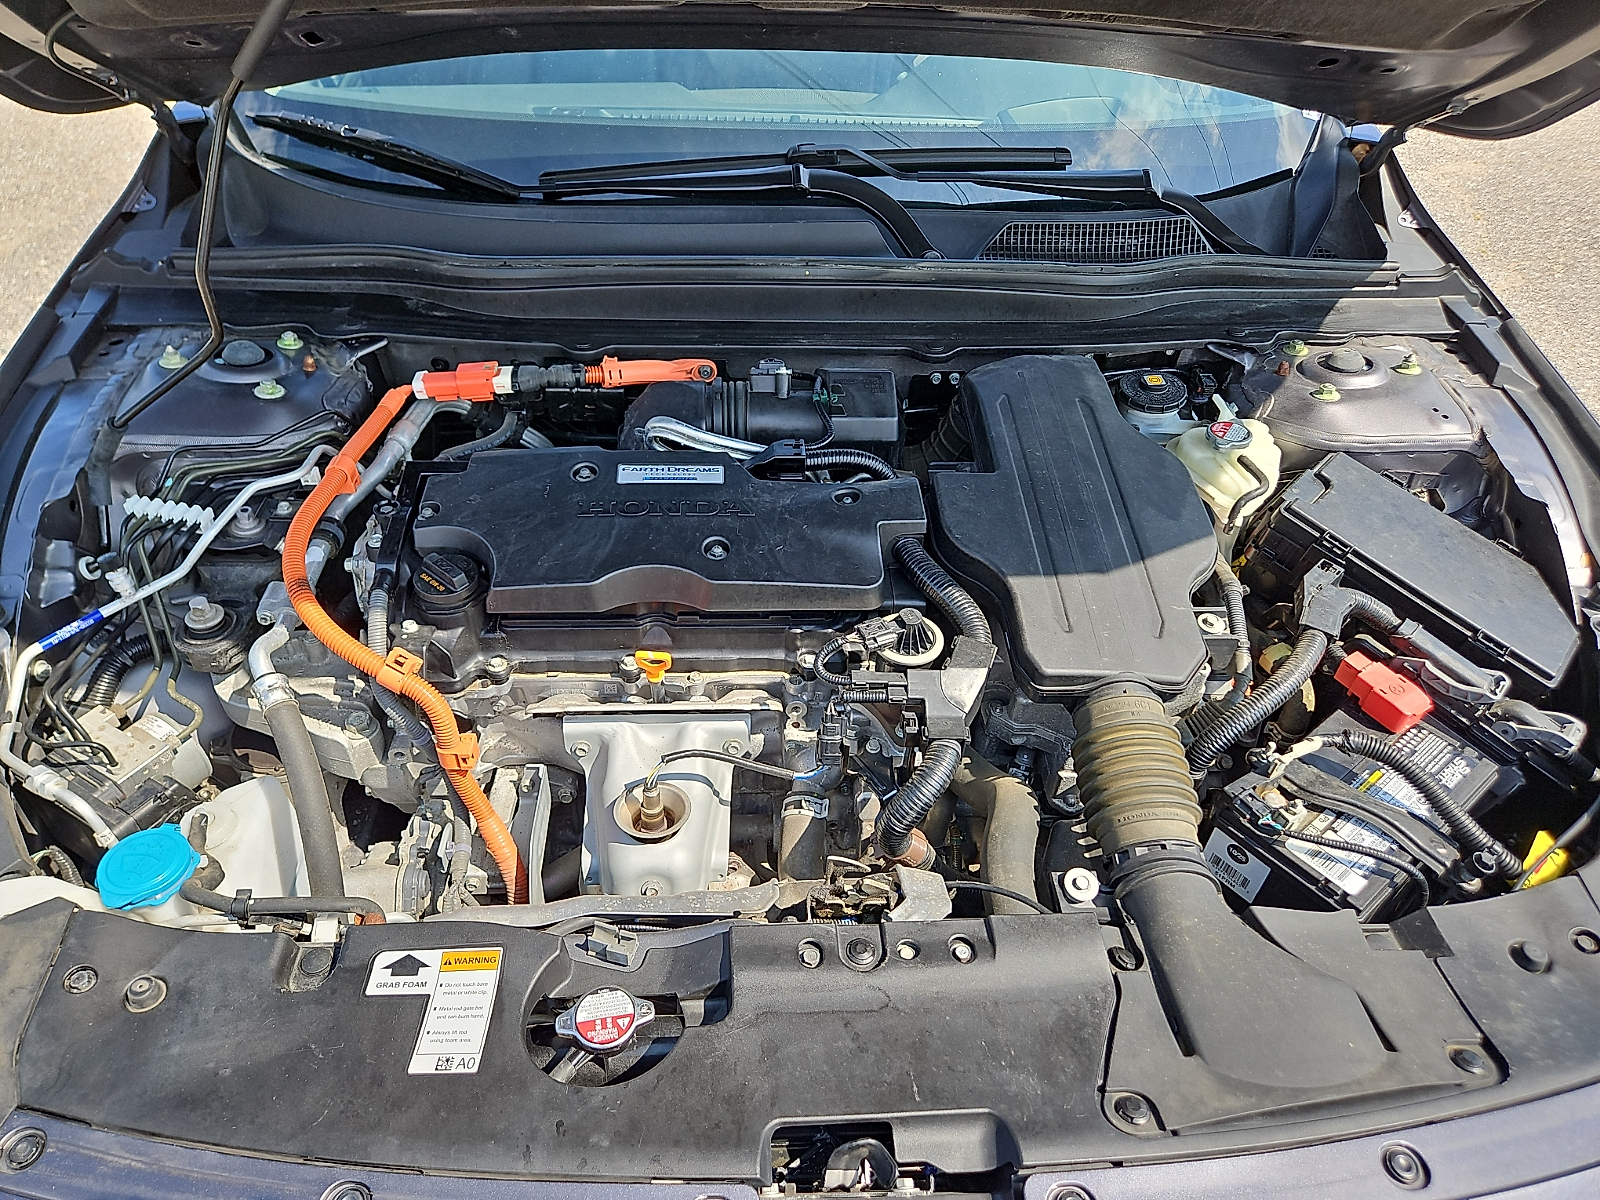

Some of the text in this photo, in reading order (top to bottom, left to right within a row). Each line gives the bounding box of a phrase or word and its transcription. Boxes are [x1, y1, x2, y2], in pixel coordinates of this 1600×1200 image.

[577, 500, 756, 517] HONDA
[454, 956, 497, 965] WARNING
[375, 981, 400, 989] GRAB
